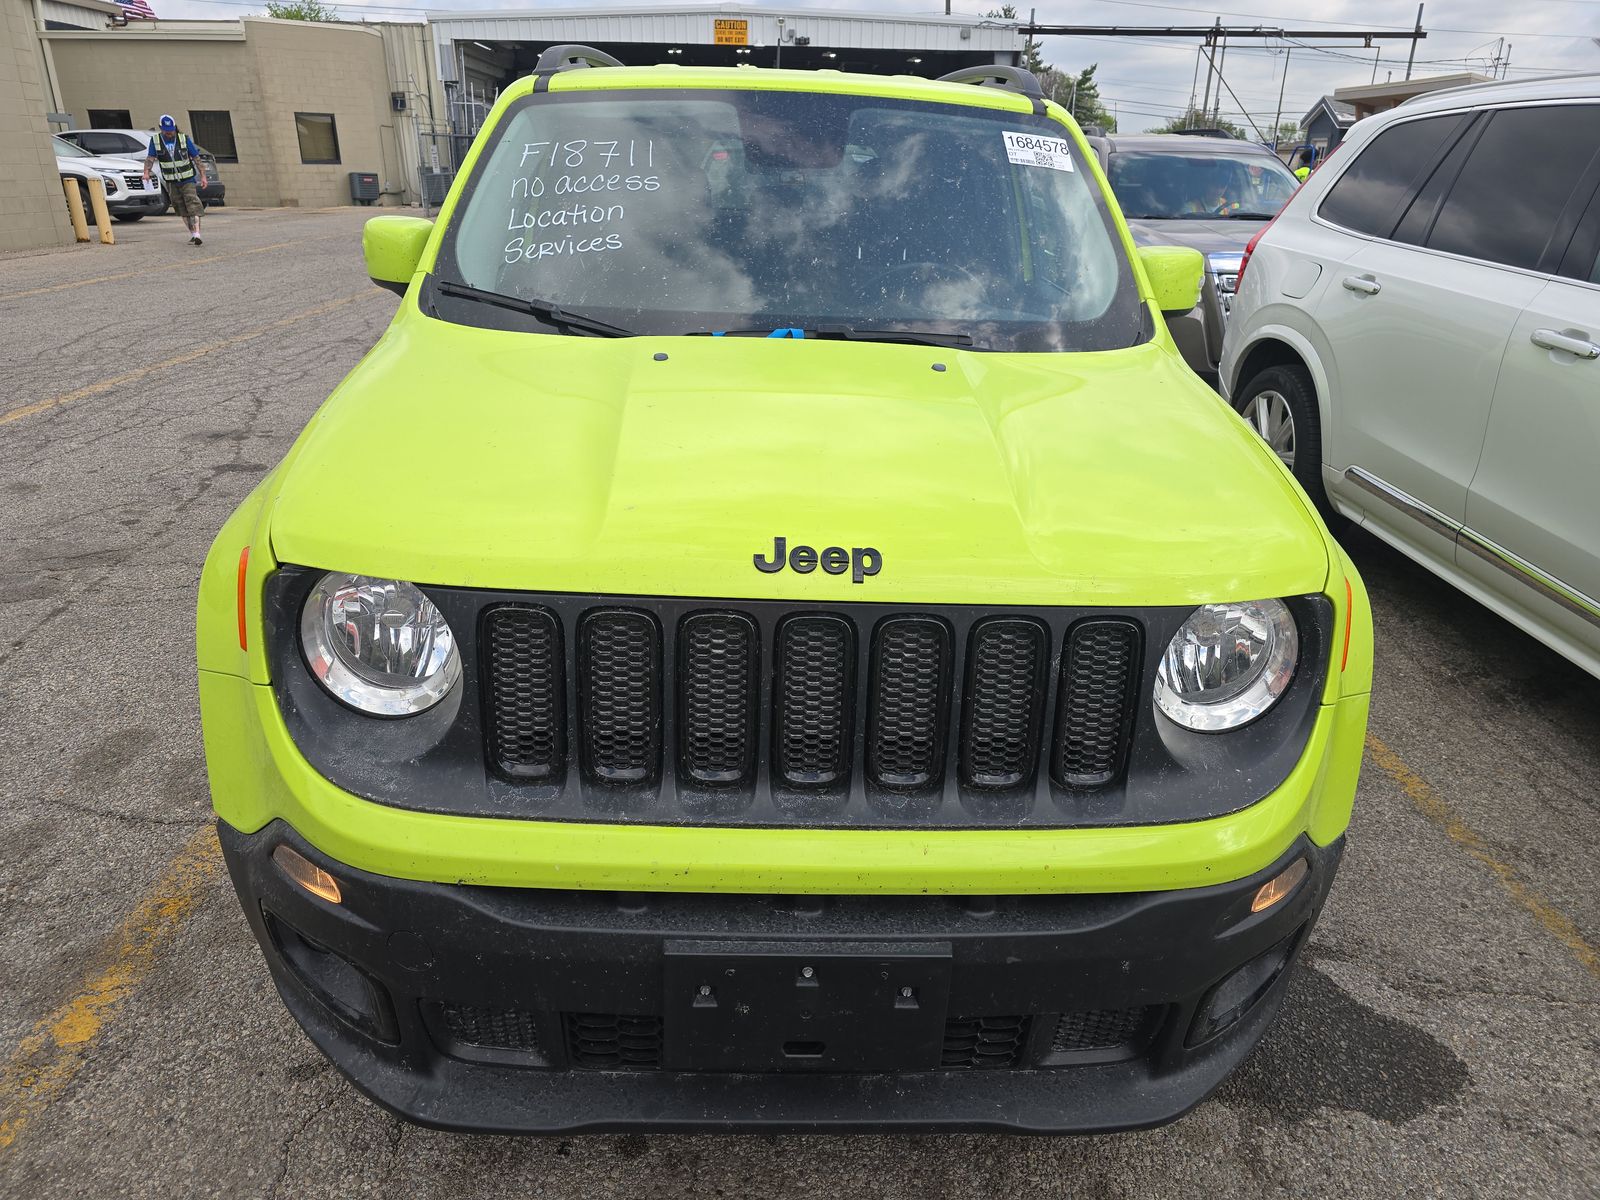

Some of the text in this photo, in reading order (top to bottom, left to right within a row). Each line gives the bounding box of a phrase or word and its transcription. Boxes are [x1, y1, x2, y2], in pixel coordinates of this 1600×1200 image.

[715, 20, 747, 29] CAUTION
[520, 139, 653, 168] F18711
[1007, 135, 1069, 155] 1684578
[511, 174, 661, 198] no access
[507, 203, 624, 231] Location
[753, 536, 883, 584] Jeep
